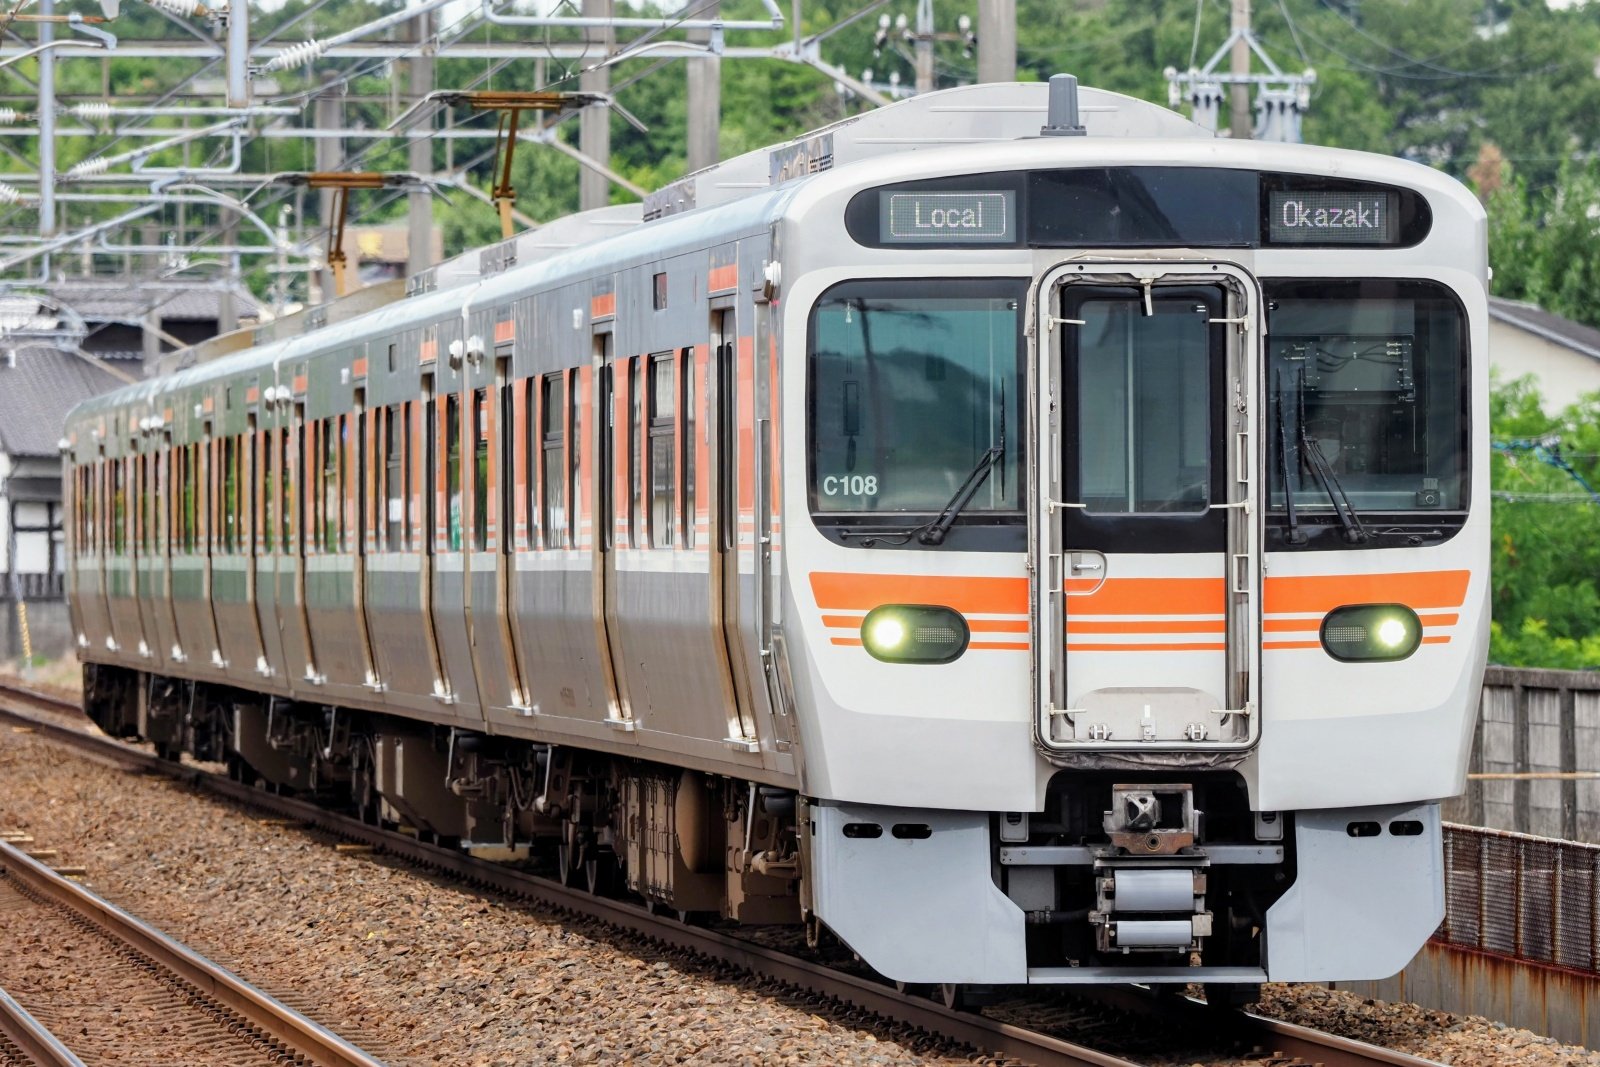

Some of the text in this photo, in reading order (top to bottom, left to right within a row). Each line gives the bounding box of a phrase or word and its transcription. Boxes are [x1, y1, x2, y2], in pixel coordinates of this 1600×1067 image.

[915, 201, 982, 227] Local
[1283, 200, 1379, 228] Okazaki
[823, 475, 878, 496] C108
